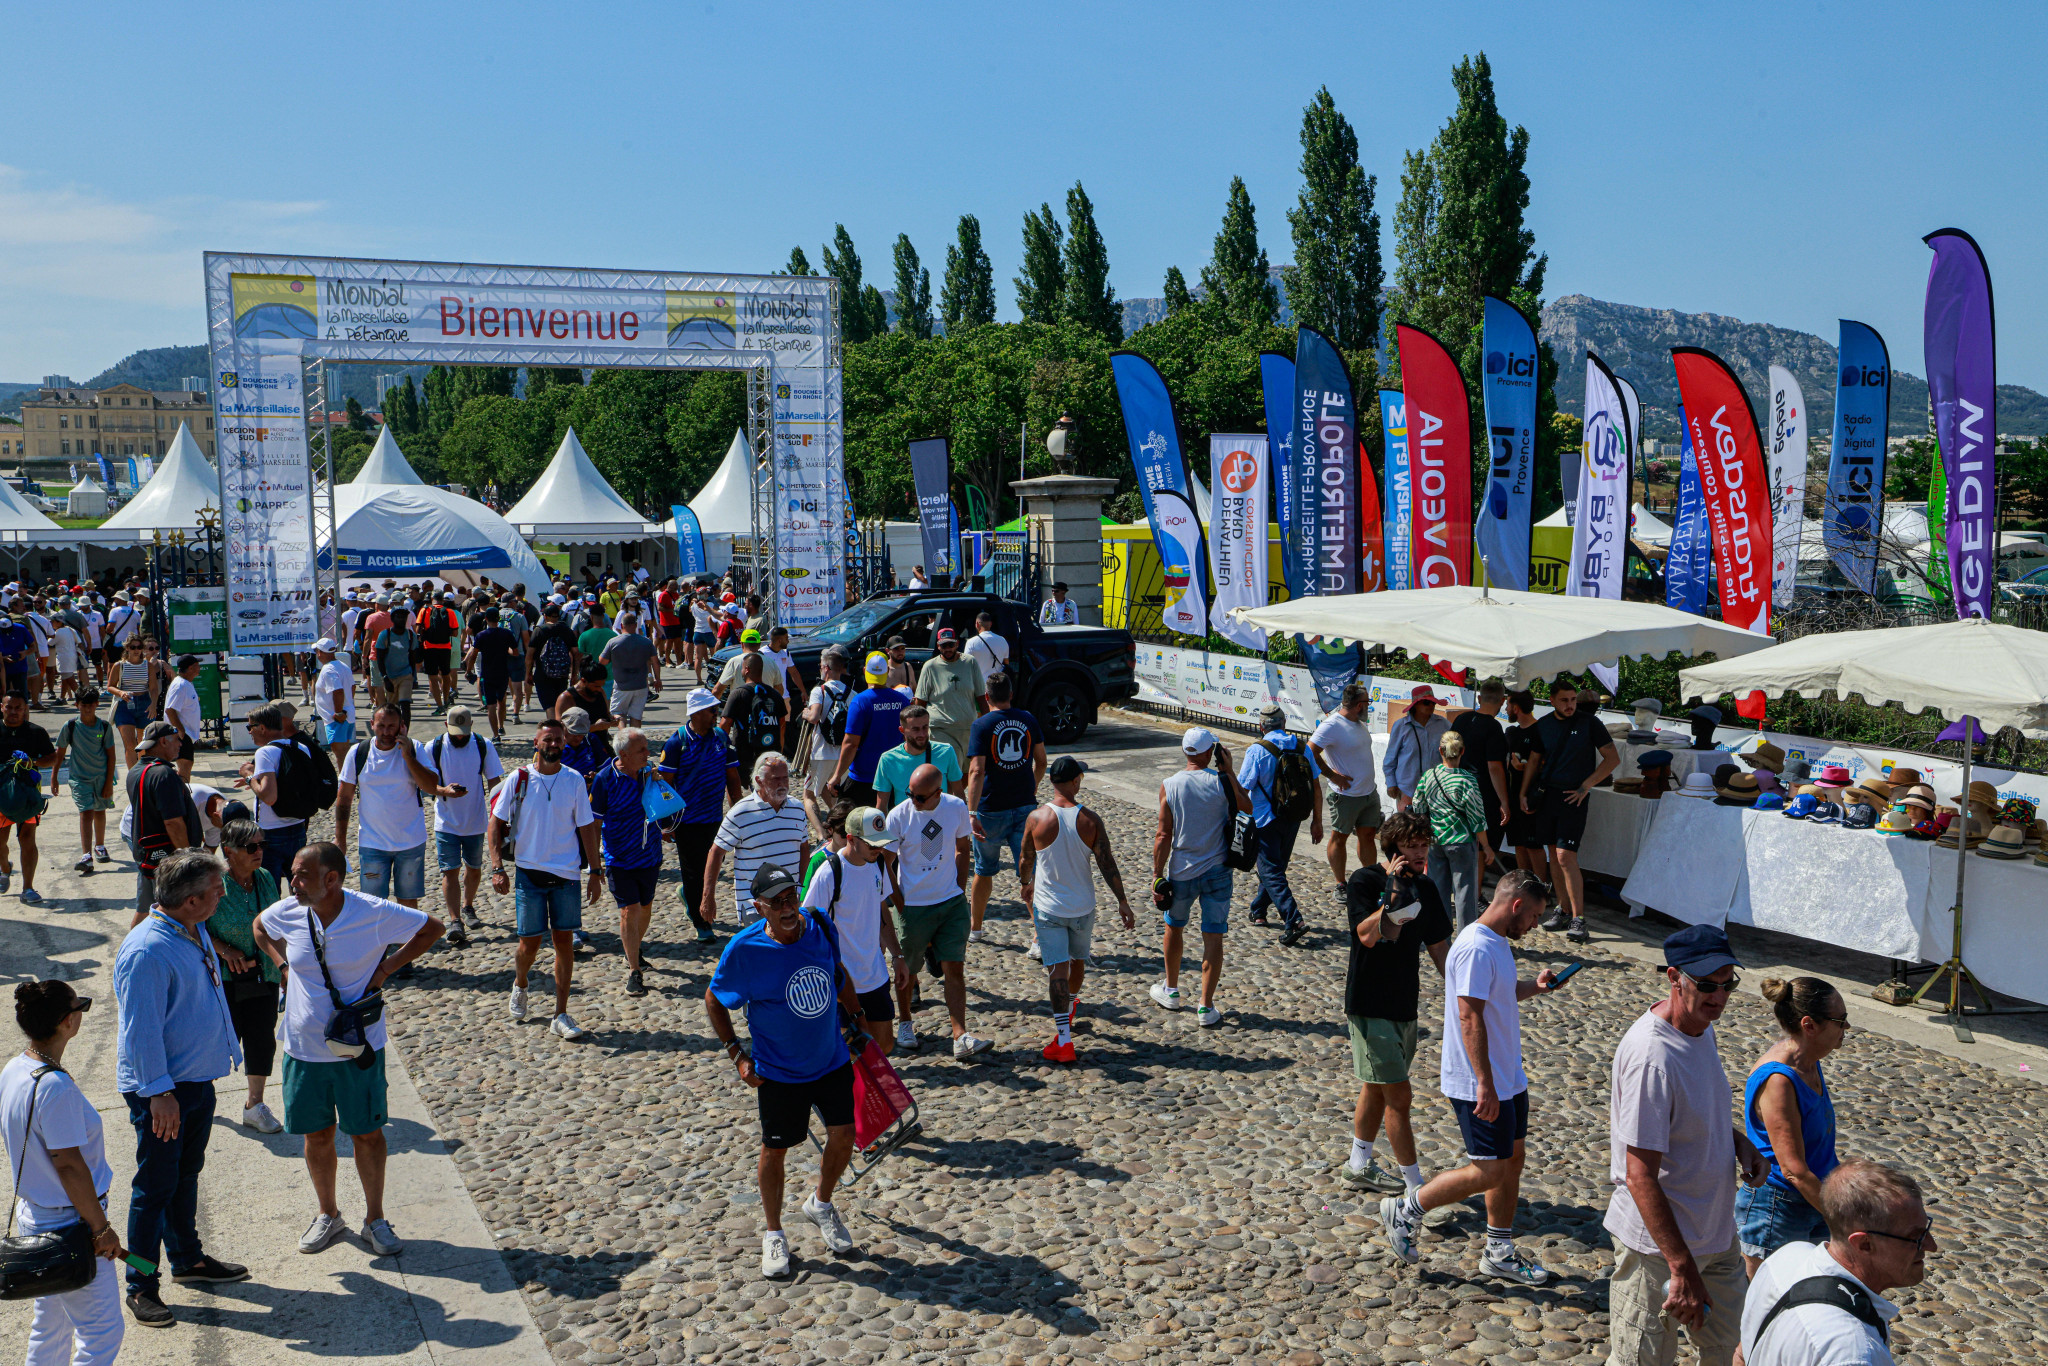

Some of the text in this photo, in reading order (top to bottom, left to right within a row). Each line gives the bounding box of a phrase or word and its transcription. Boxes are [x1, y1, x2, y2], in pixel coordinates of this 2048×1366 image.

[439, 296, 640, 341] Bienvenue
[1507, 352, 1536, 377] ici
[1861, 365, 1886, 387] ici
[1497, 376, 1532, 388] Provence
[220, 404, 300, 414] La Marseillaise
[1843, 414, 1872, 425] Radio
[1844, 426, 1856, 436] TV
[1843, 438, 1875, 450] Digital
[1512, 428, 1530, 495] Provence
[228, 484, 256, 492] Crédit
[800, 499, 818, 512] ici
[367, 555, 421, 566] ACCUEIL
[820, 568, 838, 576] NGE
[270, 590, 312, 601] RTM
[798, 586, 836, 594] VEOLIA
[243, 610, 261, 618] Ford
[234, 632, 315, 642] La Marseillaise
[873, 702, 902, 711] RICARD BOY
[762, 715, 778, 726] OM
[993, 720, 1028, 736] HARLEY-DAVIDSON
[792, 968, 820, 984] LA BOULE
